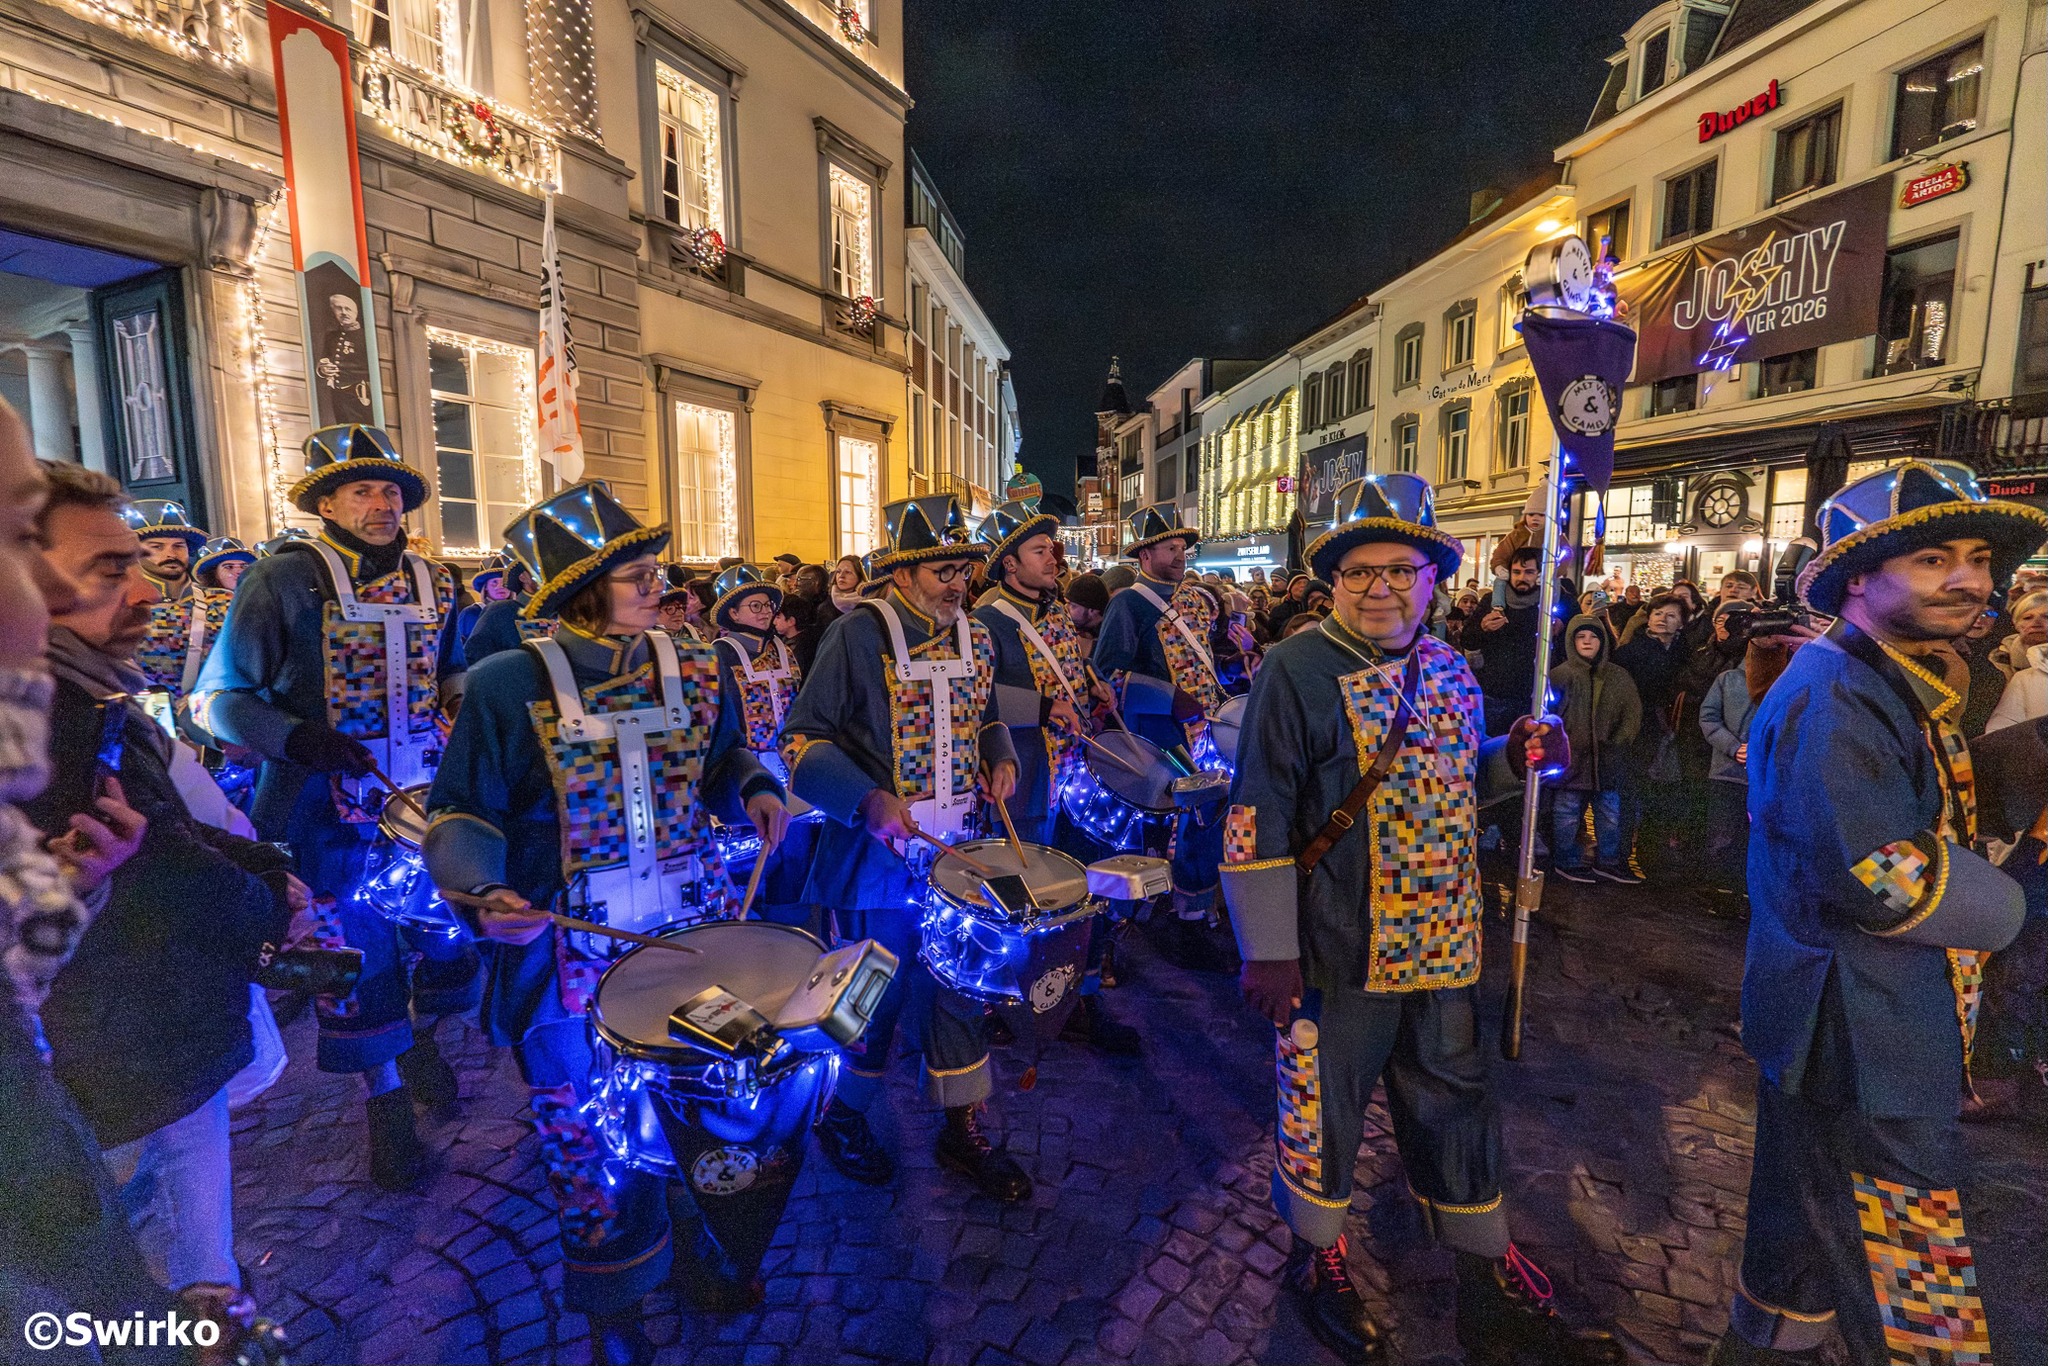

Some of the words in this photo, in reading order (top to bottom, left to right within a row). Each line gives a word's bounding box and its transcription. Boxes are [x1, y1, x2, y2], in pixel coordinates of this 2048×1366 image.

[1697, 78, 1779, 144] Duvel
[1911, 171, 1953, 192] STELLA
[1911, 180, 1954, 199] ARTOIS
[1674, 220, 1846, 330] JOSHY
[1746, 309, 1777, 336] VER
[1780, 296, 1828, 328] 2026
[1432, 385, 1446, 399] Gat
[1467, 372, 1491, 388] Mert
[1573, 382, 1593, 397] MET
[1584, 395, 1599, 414] &
[1571, 415, 1605, 430] GAMEL
[1320, 434, 1328, 446] DE
[1328, 428, 1347, 443] KLOK
[1989, 482, 2036, 496] Duvel
[1045, 982, 1056, 997] &
